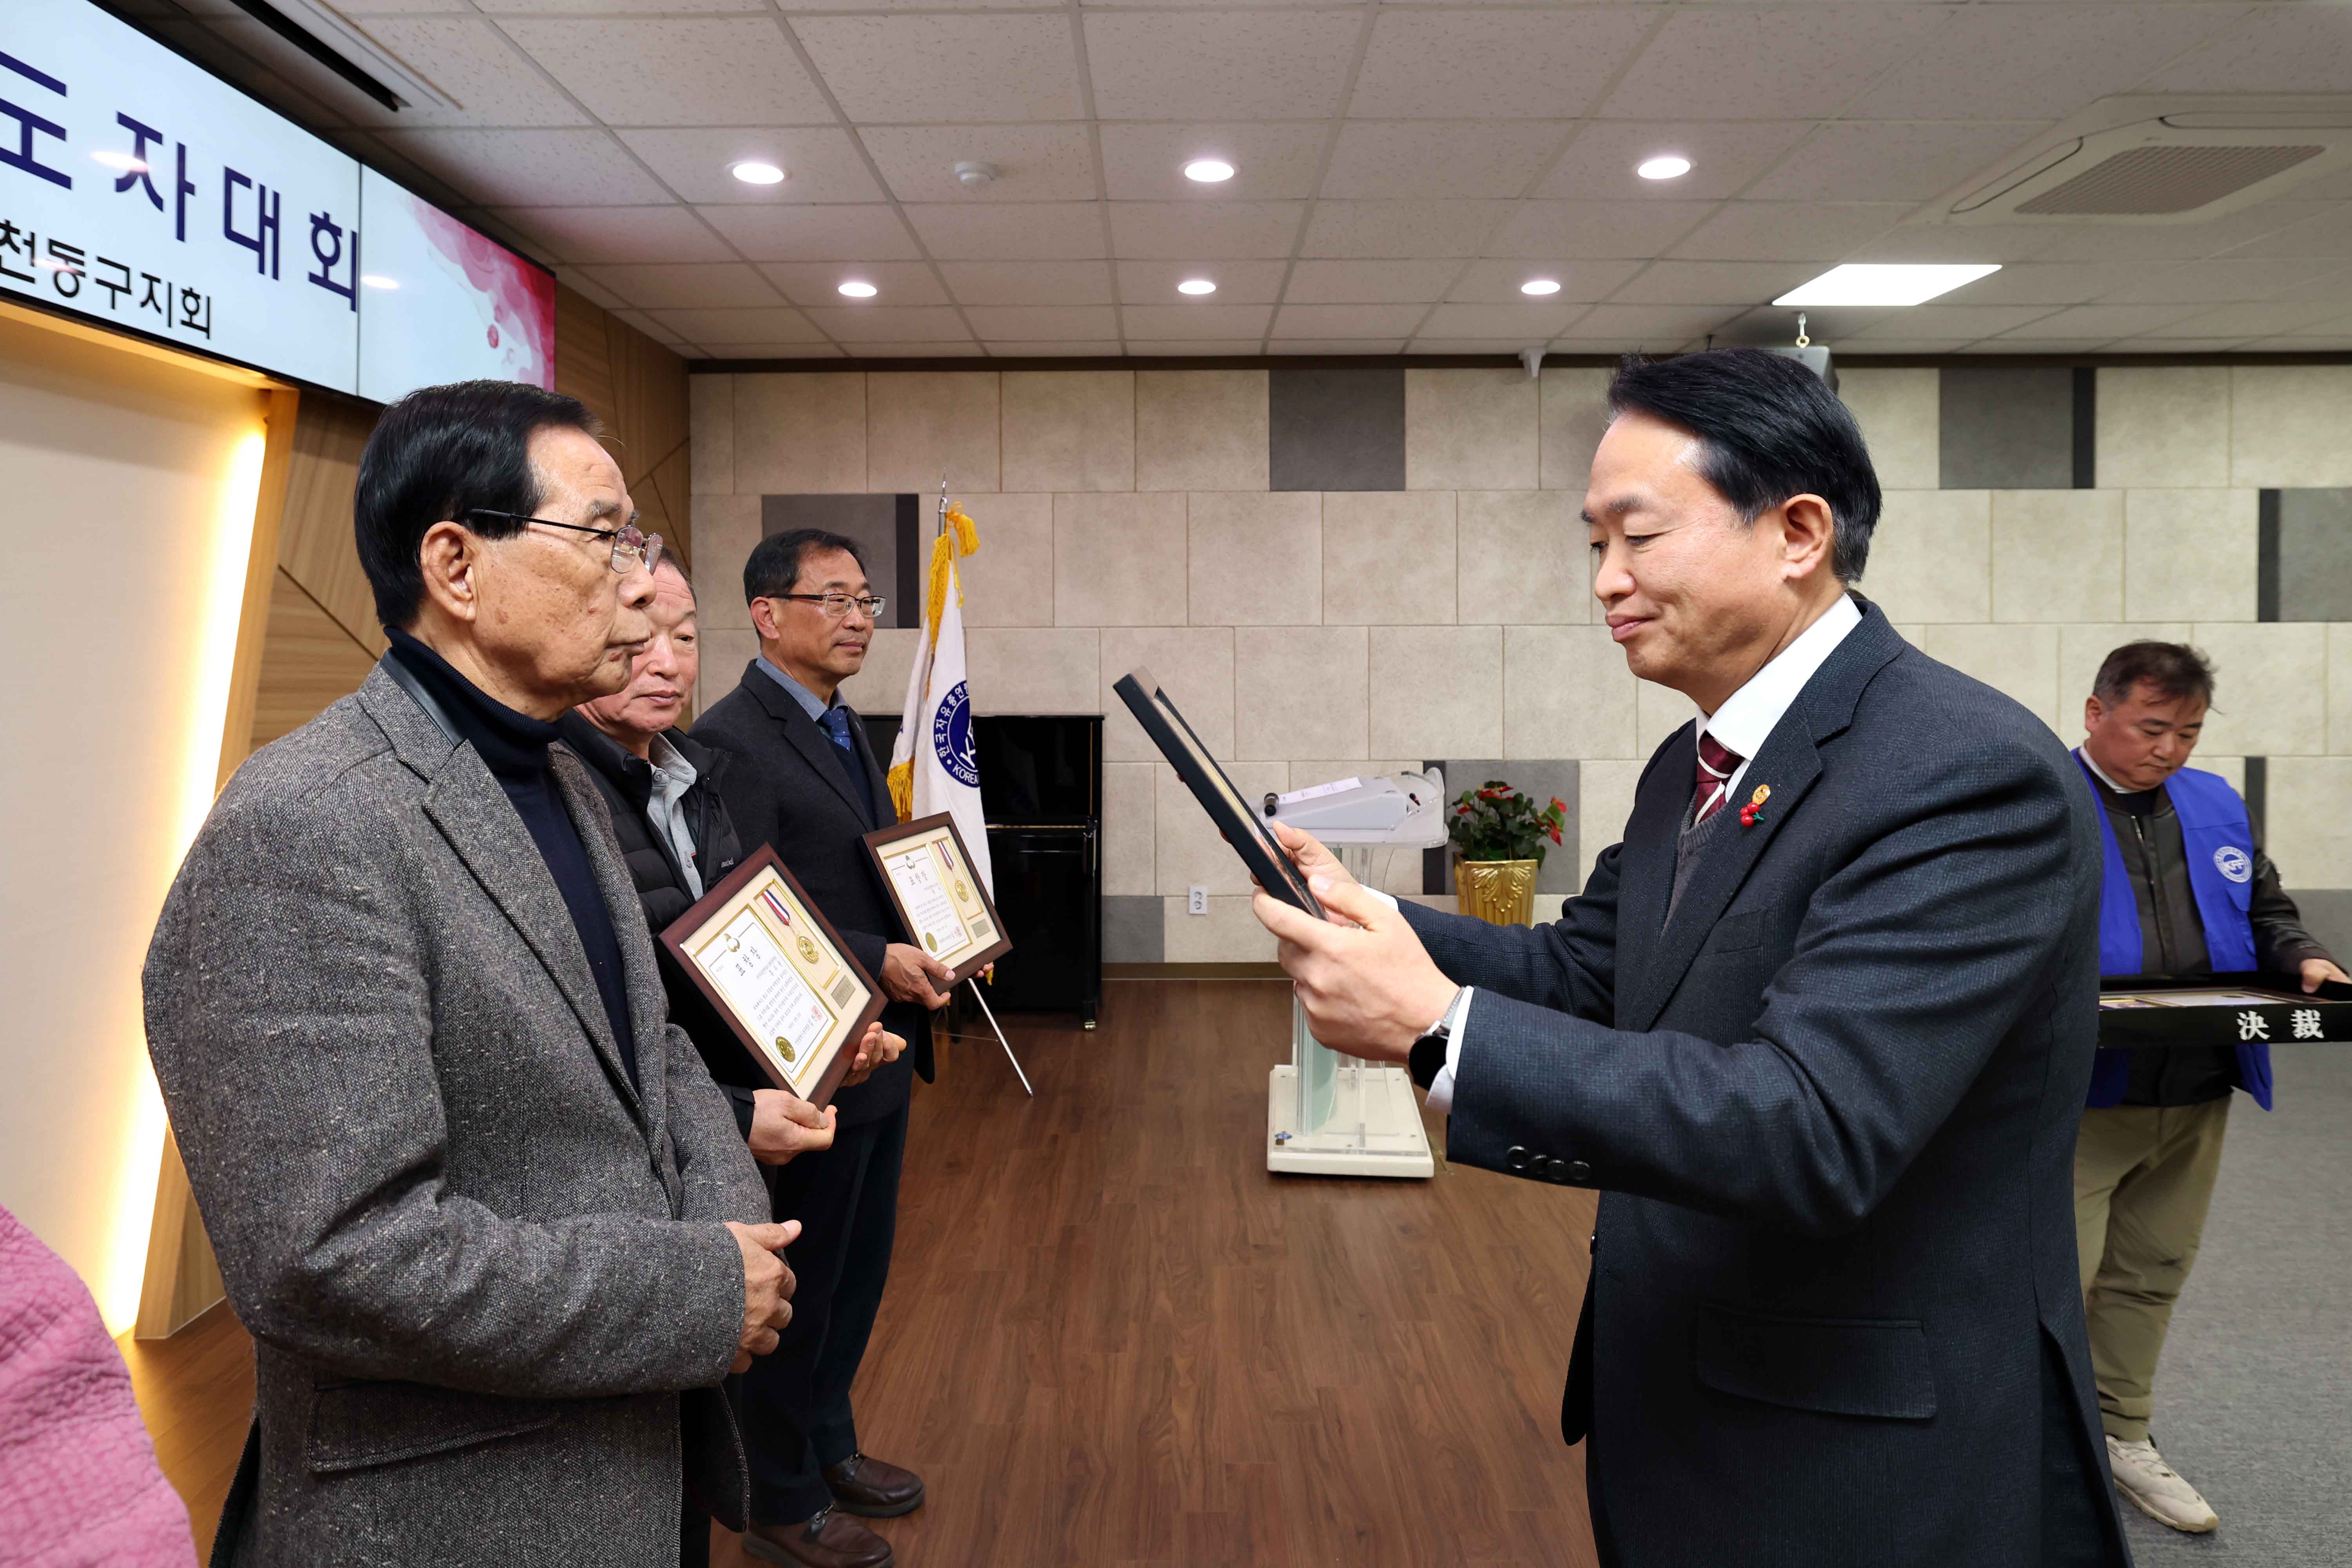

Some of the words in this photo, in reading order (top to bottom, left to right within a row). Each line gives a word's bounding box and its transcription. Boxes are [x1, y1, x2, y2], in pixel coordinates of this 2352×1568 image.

[0, 219, 212, 340] 천동구지회
[735, 946, 760, 976] 표창장
[2236, 1009, 2325, 1041] 決裁
